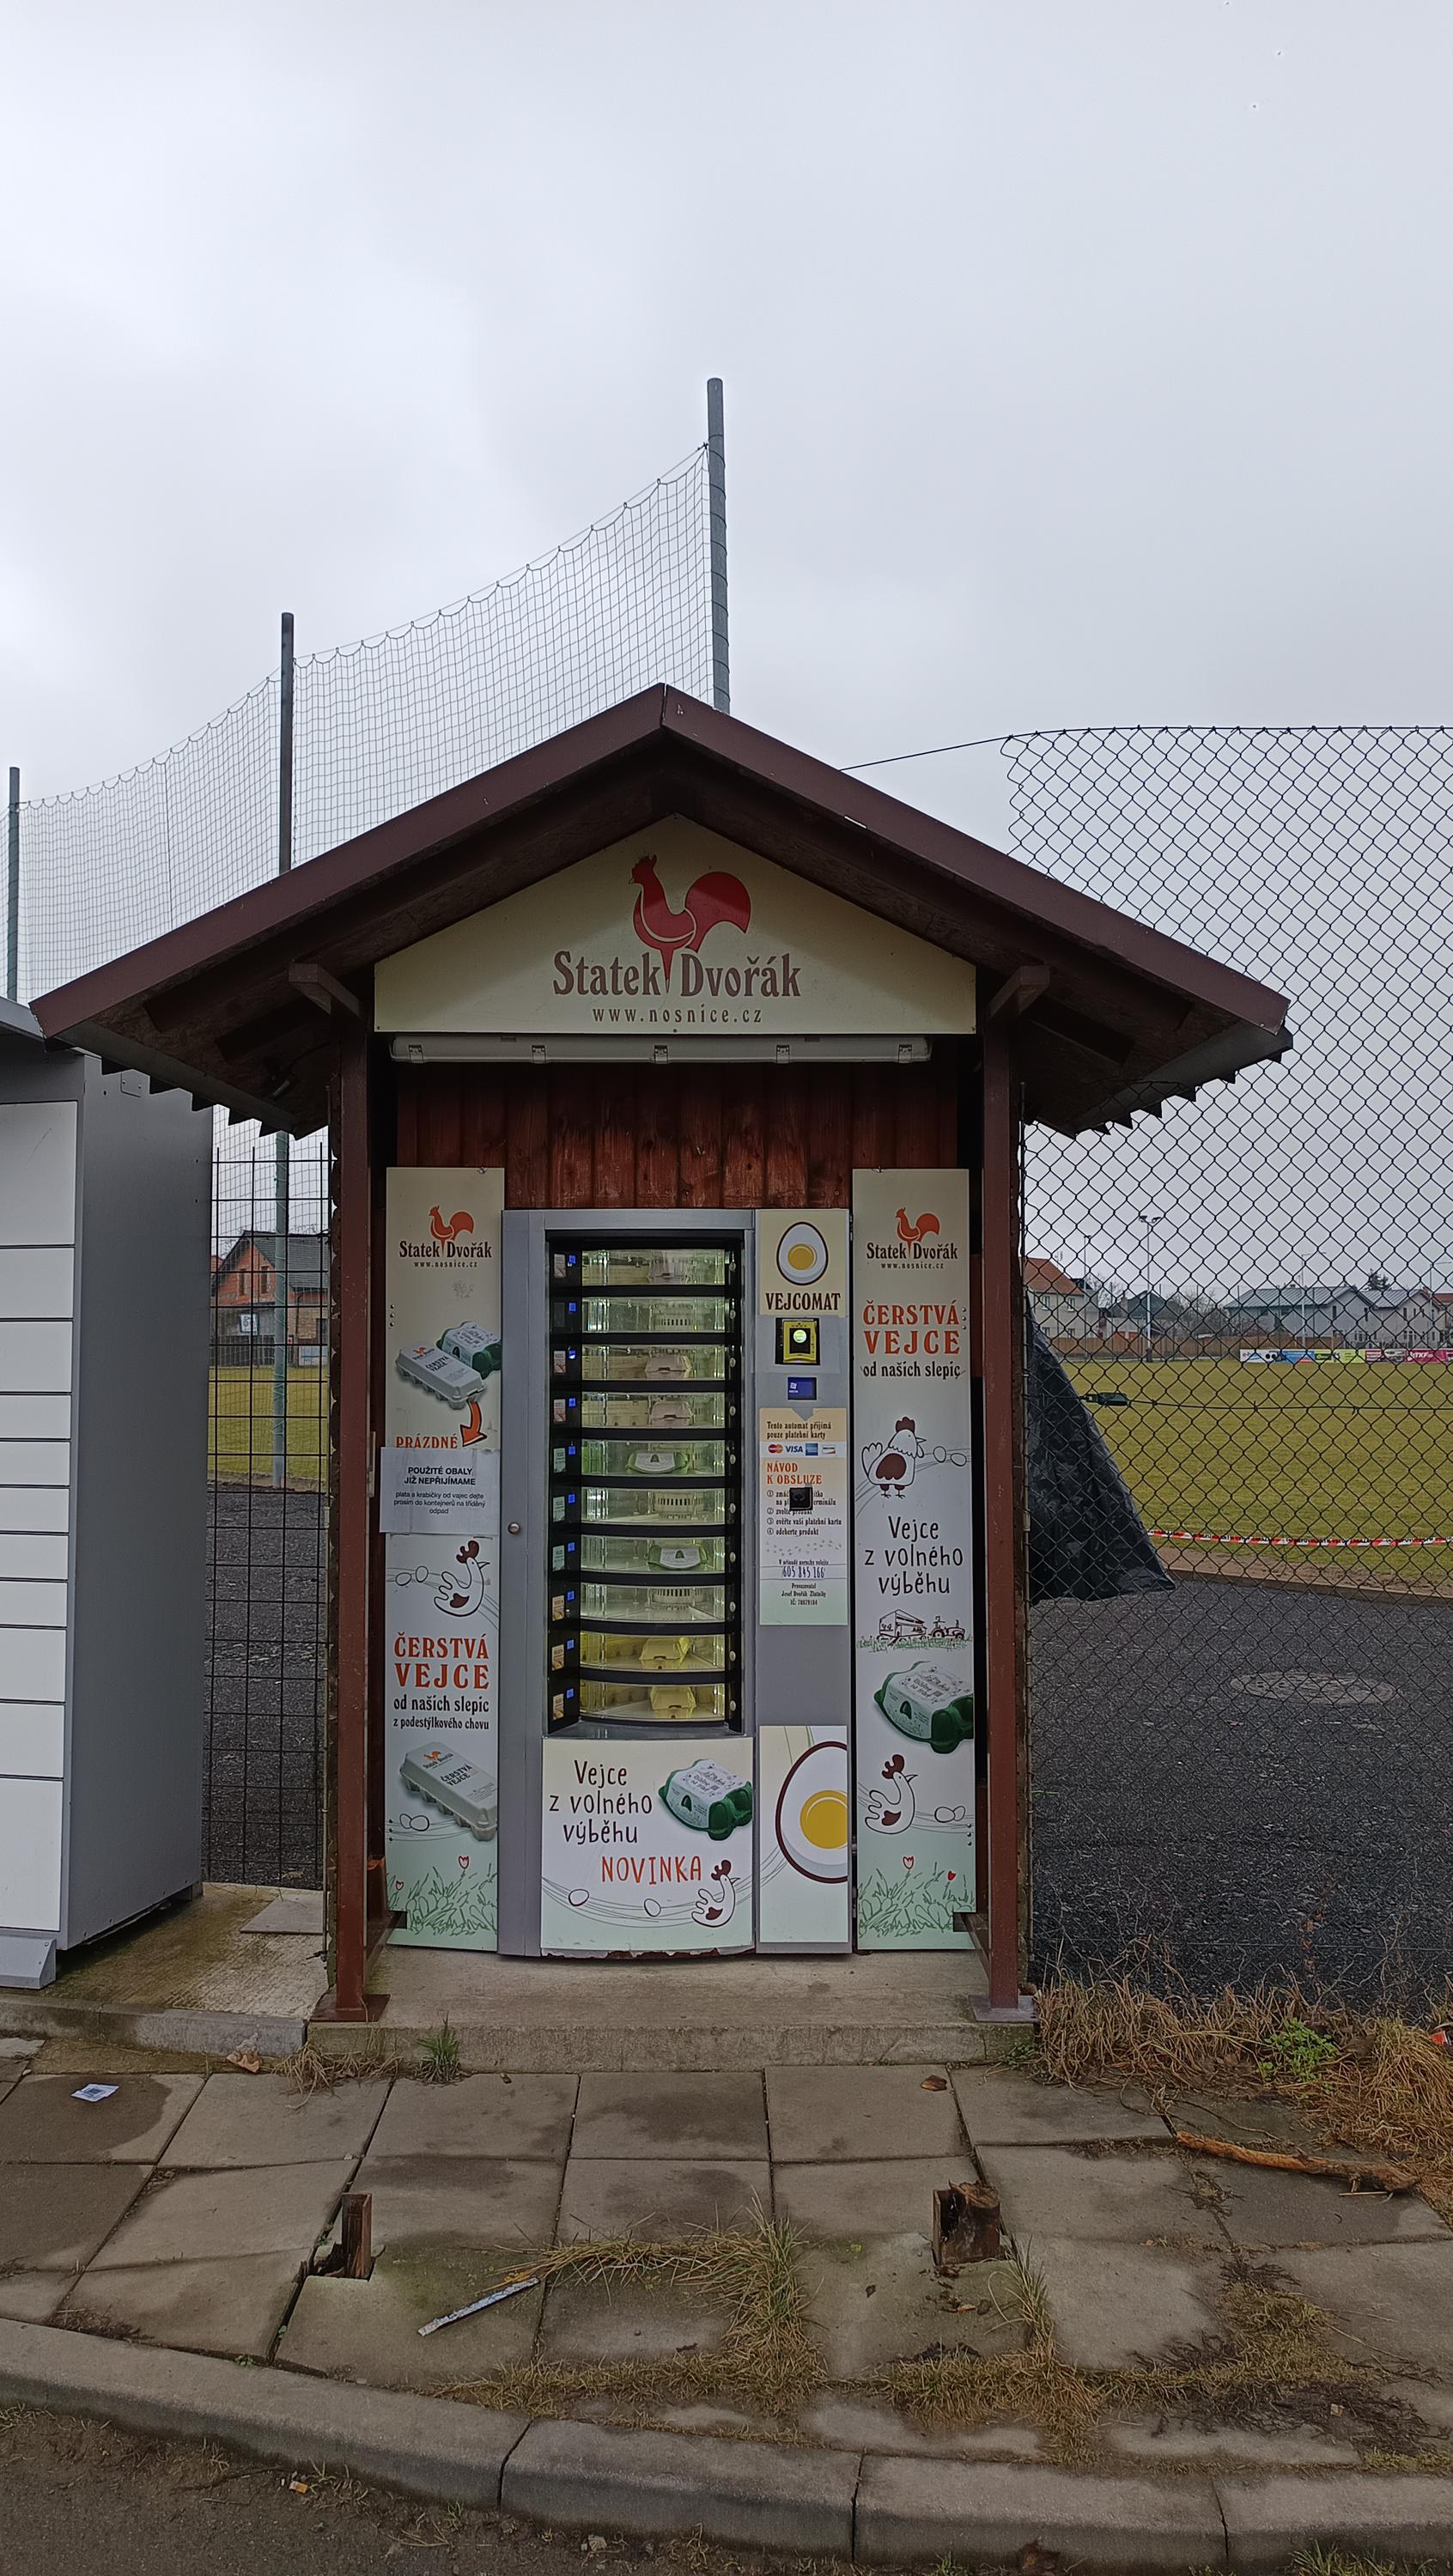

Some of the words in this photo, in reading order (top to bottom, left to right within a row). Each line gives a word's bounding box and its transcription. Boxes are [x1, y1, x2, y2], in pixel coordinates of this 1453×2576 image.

[553, 951, 661, 995] Statek
[680, 952, 801, 997] Dvořák
[593, 1004, 762, 1023] www.nosnice.cz
[399, 1240, 440, 1258] Statek
[447, 1240, 492, 1258] Dvořák
[866, 1242, 907, 1260] Statek
[913, 1242, 958, 1260] Dvořák
[414, 1260, 477, 1268] www.nosnice.cz
[765, 1292, 841, 1310] VEJCOMAT
[863, 1299, 960, 1325] ČERSTVÁ
[863, 1330, 960, 1354] VEJCE
[863, 1361, 877, 1377] od
[881, 1361, 921, 1377] našich
[925, 1361, 960, 1380] slepic
[784, 1421, 808, 1430] automat
[396, 1433, 459, 1449] PRÁZDNÉ
[810, 1431, 826, 1440] karty
[408, 1466, 443, 1475] POUŽITÉ
[767, 1461, 798, 1473] NÁVOD
[404, 1476, 417, 1485] JIŽ
[767, 1474, 773, 1484] K
[777, 1474, 822, 1485] OBSLUZE
[888, 1516, 939, 1543] Vejce
[865, 1549, 874, 1566] z
[885, 1544, 963, 1567] volného
[783, 1565, 796, 1577] 605
[798, 1565, 811, 1578] 845
[813, 1566, 824, 1578] 166
[878, 1571, 950, 1596] výběhu
[394, 1631, 489, 1659] ČERSTVÁ
[394, 1662, 489, 1689] VEJCE
[393, 1694, 407, 1710] od
[411, 1694, 450, 1711] našich
[454, 1695, 489, 1715] slepic
[393, 1718, 398, 1727] z
[400, 1716, 463, 1730] podestýlkového
[465, 1717, 489, 1729] chovu
[440, 1763, 472, 1782] ČERSTVÁ
[446, 1773, 471, 1786] VEJCE
[574, 1759, 627, 1789] Vejce
[549, 1795, 560, 1812] z
[570, 1790, 653, 1814] volného
[563, 1819, 638, 1844] výběhu
[602, 1856, 702, 1885] NOVINKA
